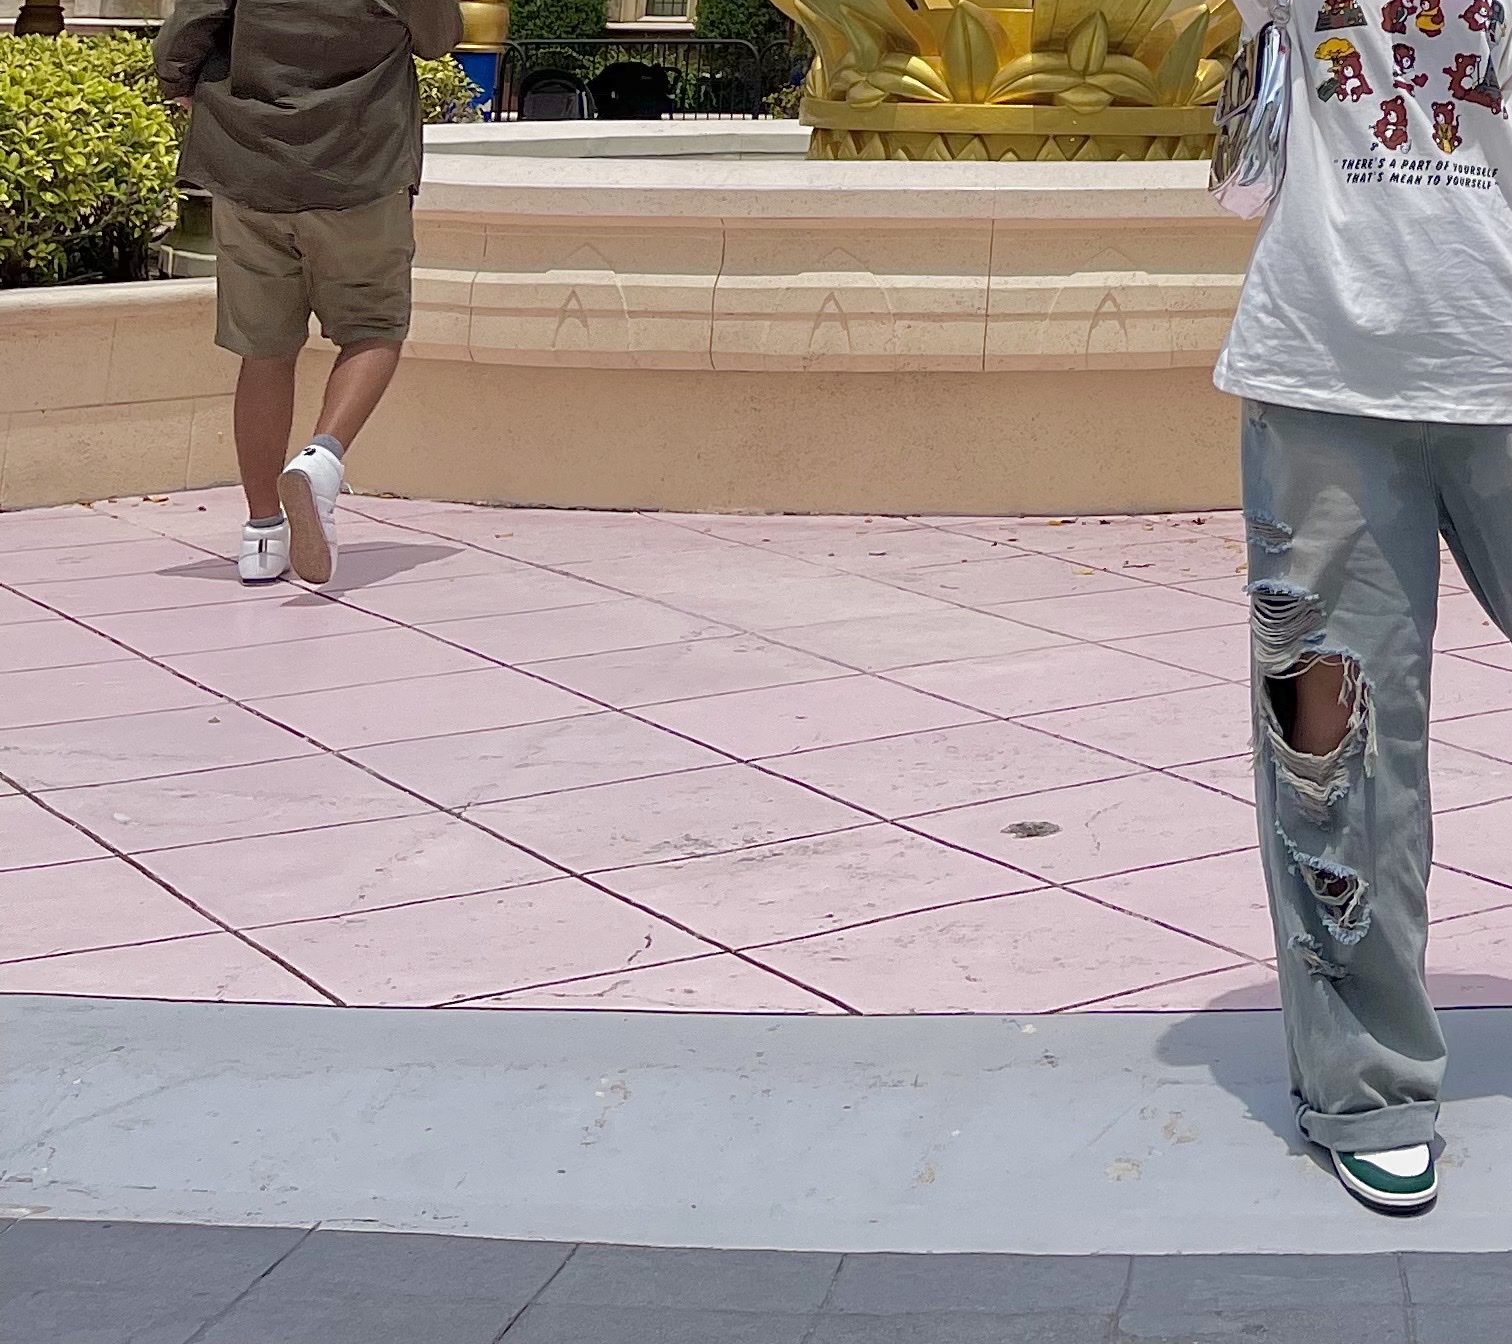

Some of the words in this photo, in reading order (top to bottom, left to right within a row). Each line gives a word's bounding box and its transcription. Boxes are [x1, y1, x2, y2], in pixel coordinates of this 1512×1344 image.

[1389, 158, 1397, 169] A
[1400, 159, 1432, 171] PART
[1435, 160, 1450, 171] OF
[1453, 162, 1498, 178] YOURSELF
[1389, 172, 1423, 185] MEAN
[1427, 175, 1441, 186] TO
